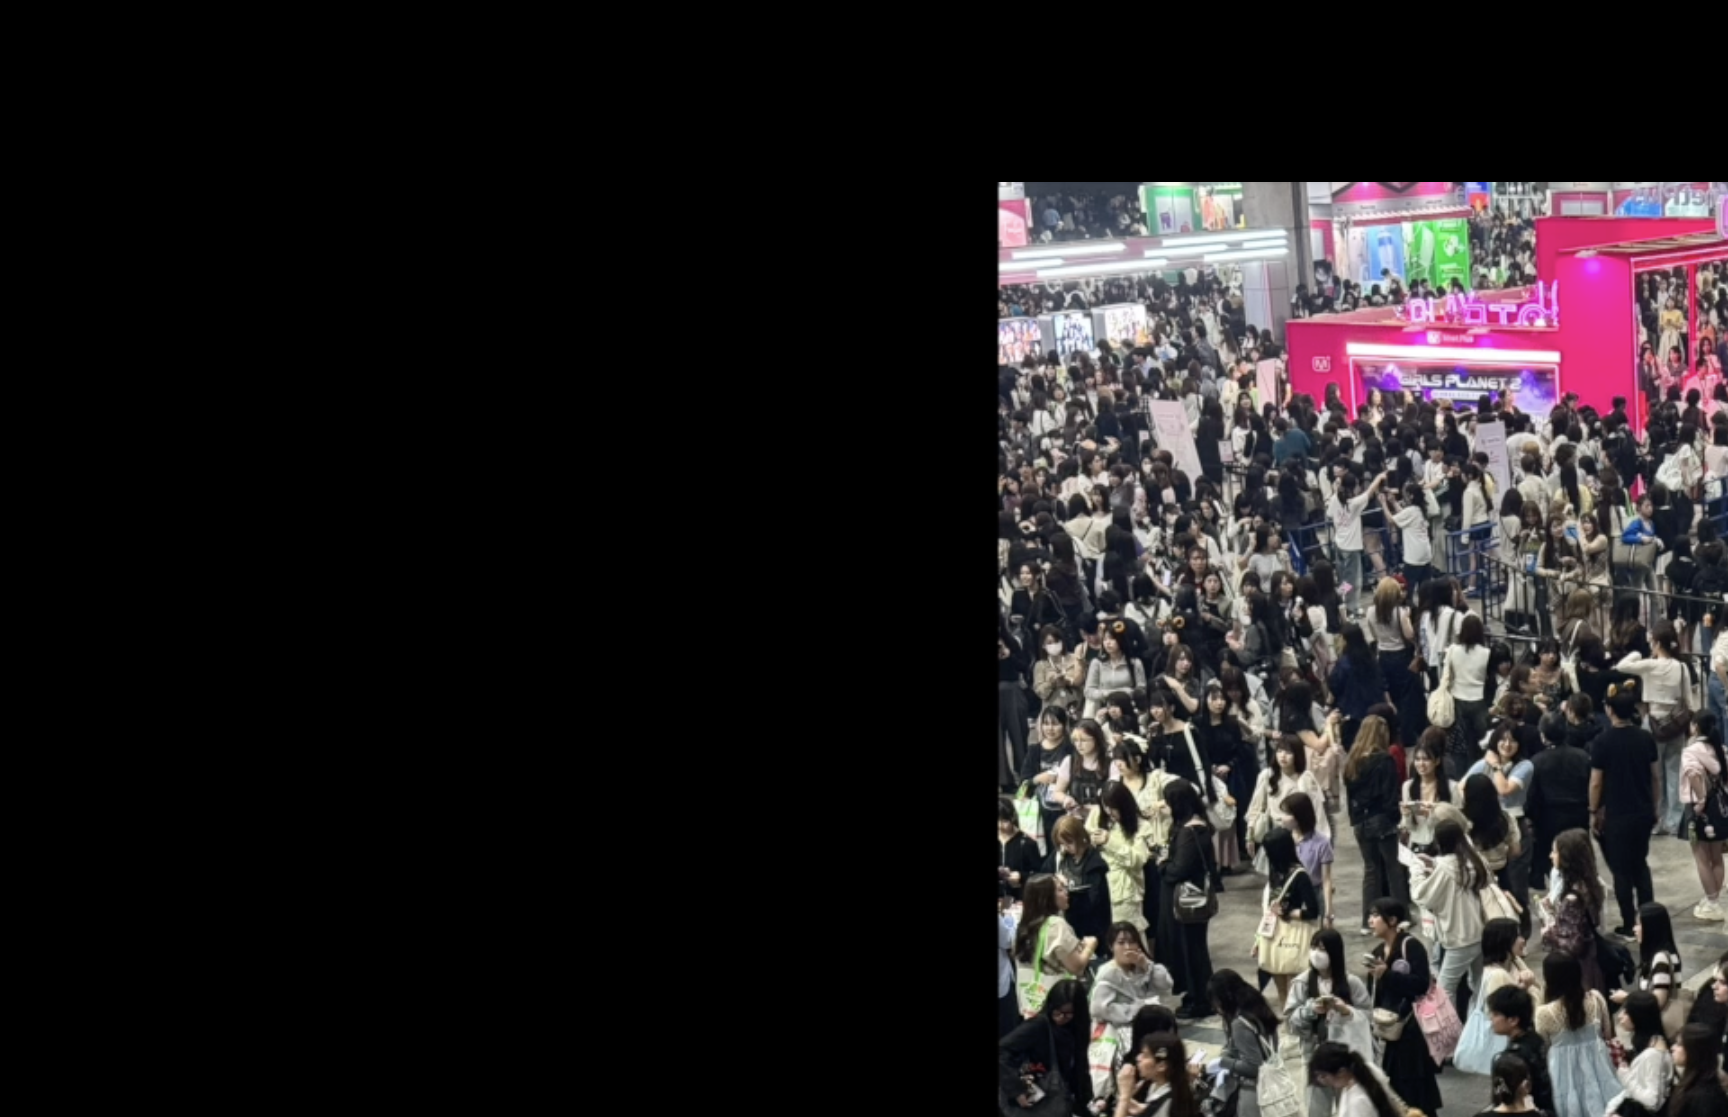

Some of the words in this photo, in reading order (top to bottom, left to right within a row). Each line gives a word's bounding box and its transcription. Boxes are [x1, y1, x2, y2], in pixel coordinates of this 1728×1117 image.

[1400, 374, 1443, 390] GIRLS
[1444, 374, 1508, 390] PLANET
[1509, 376, 1523, 390] 2
